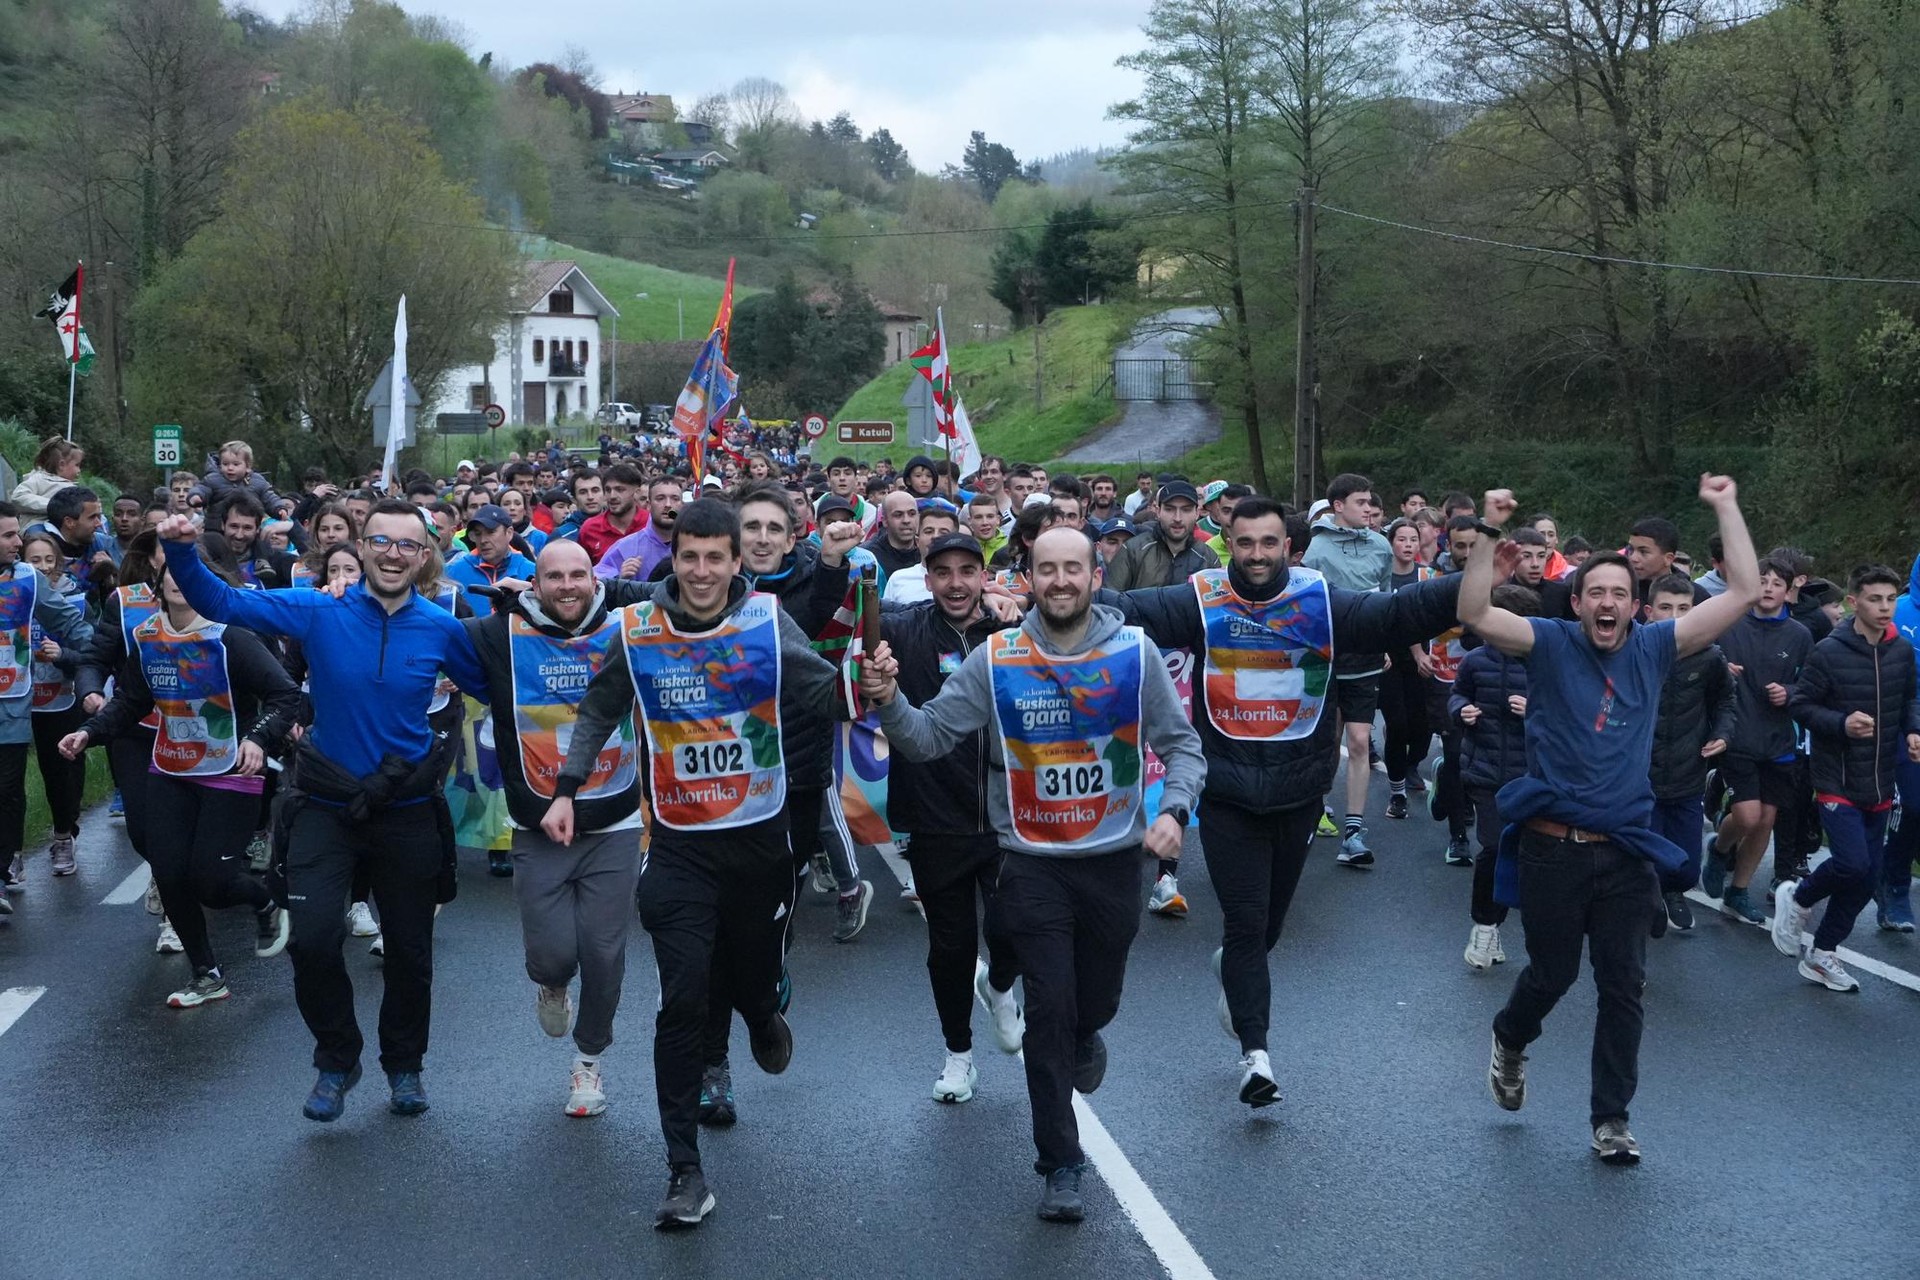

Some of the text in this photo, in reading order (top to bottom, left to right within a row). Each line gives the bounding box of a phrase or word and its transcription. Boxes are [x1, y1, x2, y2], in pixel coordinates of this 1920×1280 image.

[488, 412, 499, 420] 70
[809, 422, 821, 430] 70
[859, 428, 890, 437] Katuin
[158, 450, 176, 461] 30
[743, 607, 768, 618] eitb
[539, 663, 587, 675] Euskara
[152, 674, 178, 688] gara
[546, 674, 589, 692] gara
[652, 674, 705, 688] Euskara
[660, 686, 706, 709] gara
[1015, 698, 1069, 710] Euskara
[1022, 710, 1070, 730] gara
[1215, 706, 1288, 721] 24.korrika
[684, 744, 744, 774] 3102
[750, 775, 774, 796] aek
[1045, 764, 1104, 796] 3102
[658, 782, 738, 804] 24.korrika
[1107, 793, 1131, 816] aek
[1017, 805, 1096, 824] 24.korrika
